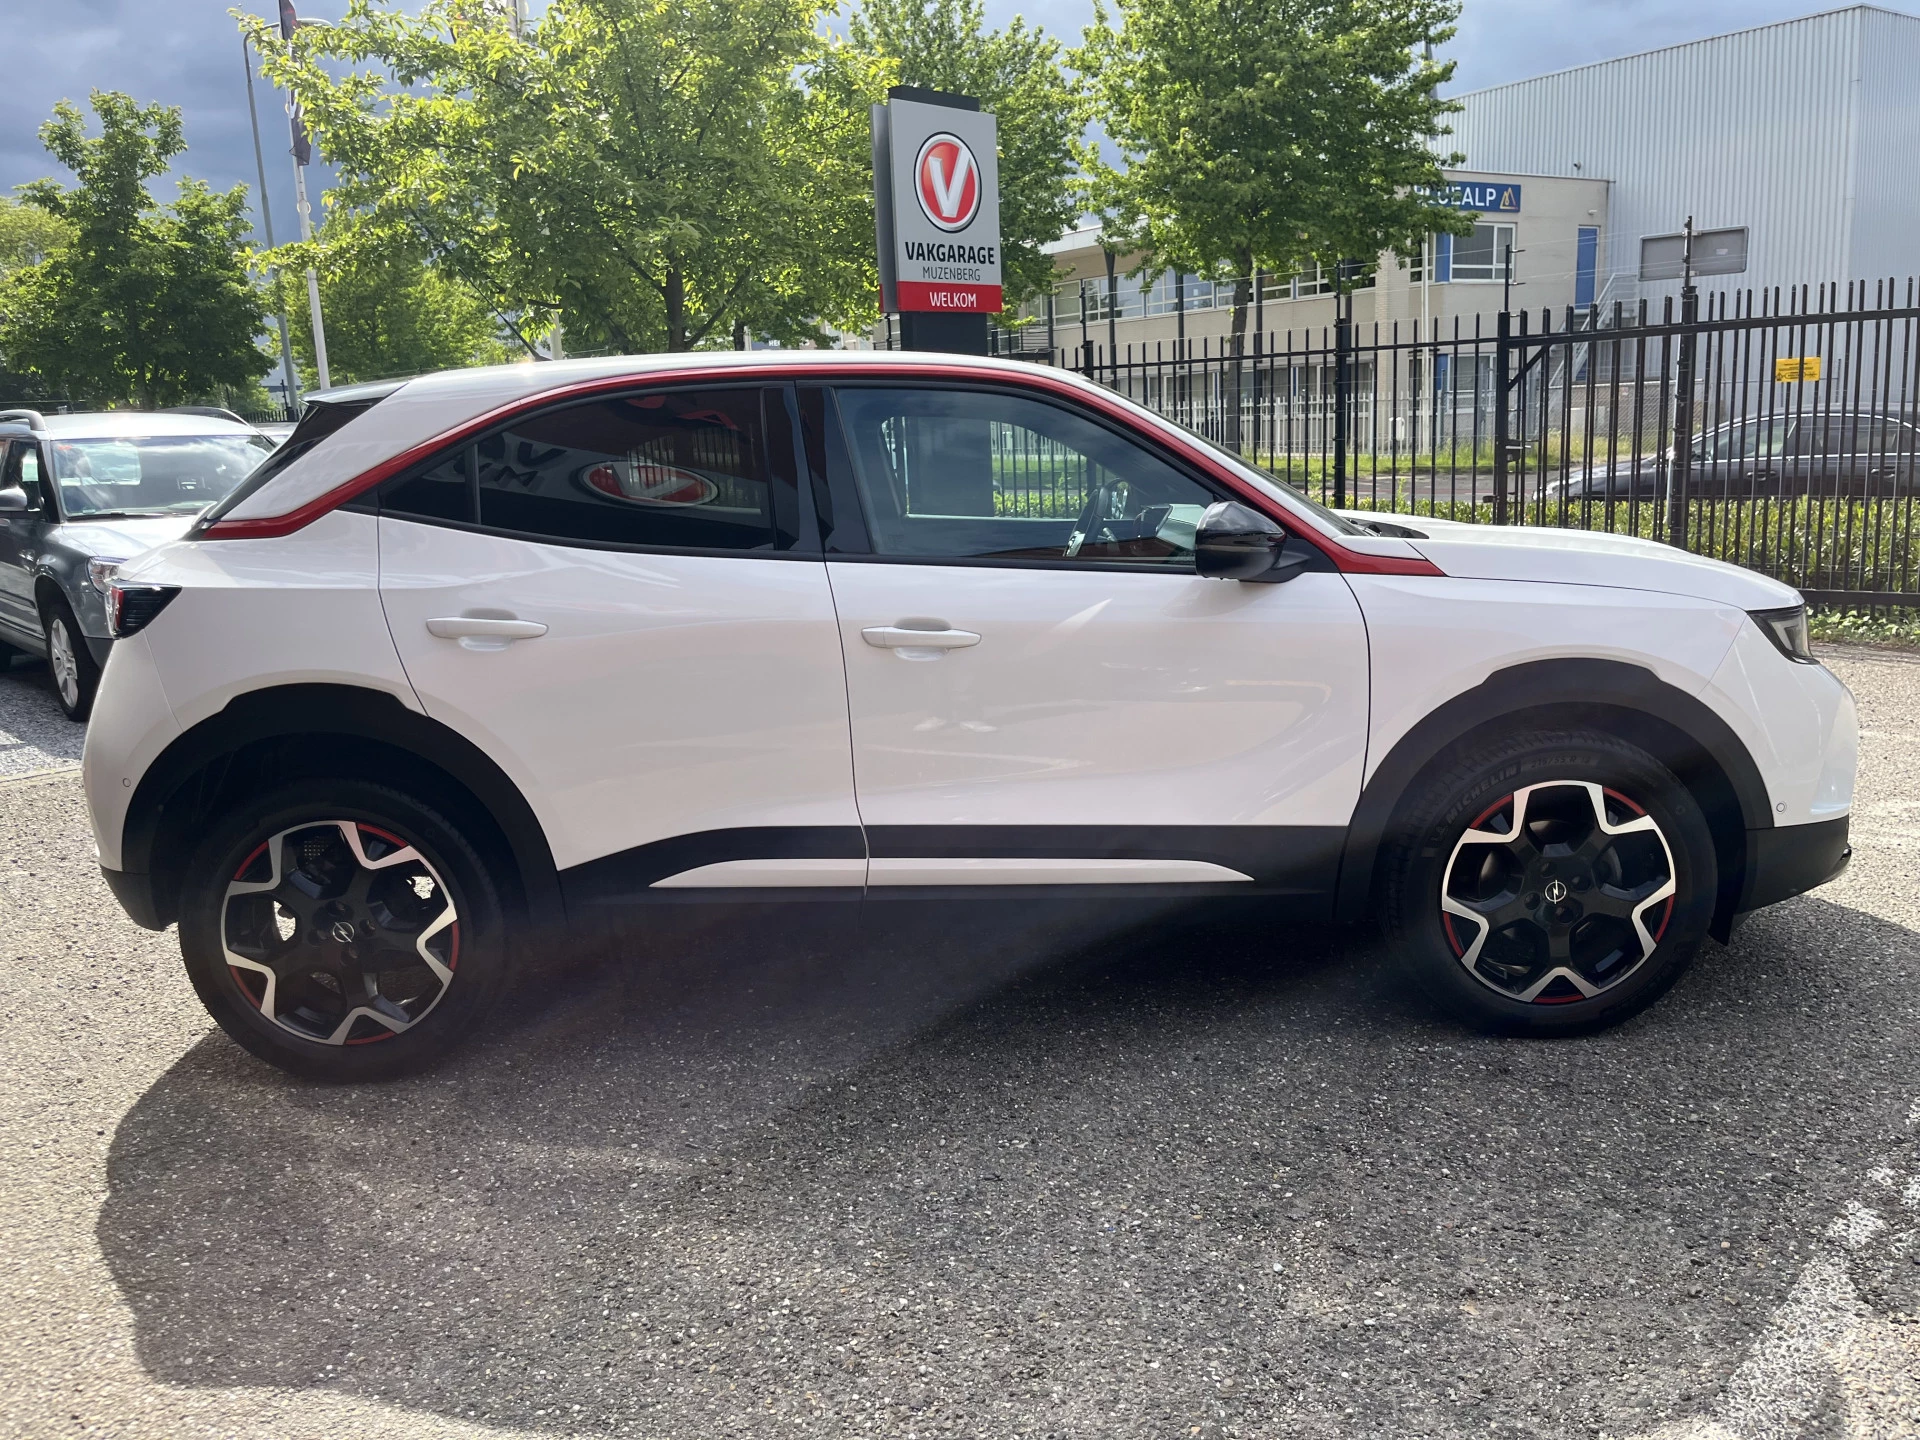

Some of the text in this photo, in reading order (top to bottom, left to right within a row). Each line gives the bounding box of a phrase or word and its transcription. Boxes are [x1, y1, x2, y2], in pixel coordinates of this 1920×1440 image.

[928, 145, 971, 218] V
[905, 241, 995, 265] VAKGARAGE
[923, 266, 981, 281] MUZENBERG
[929, 291, 977, 308] WELKOM
[1446, 764, 1518, 825] MICHELIN
